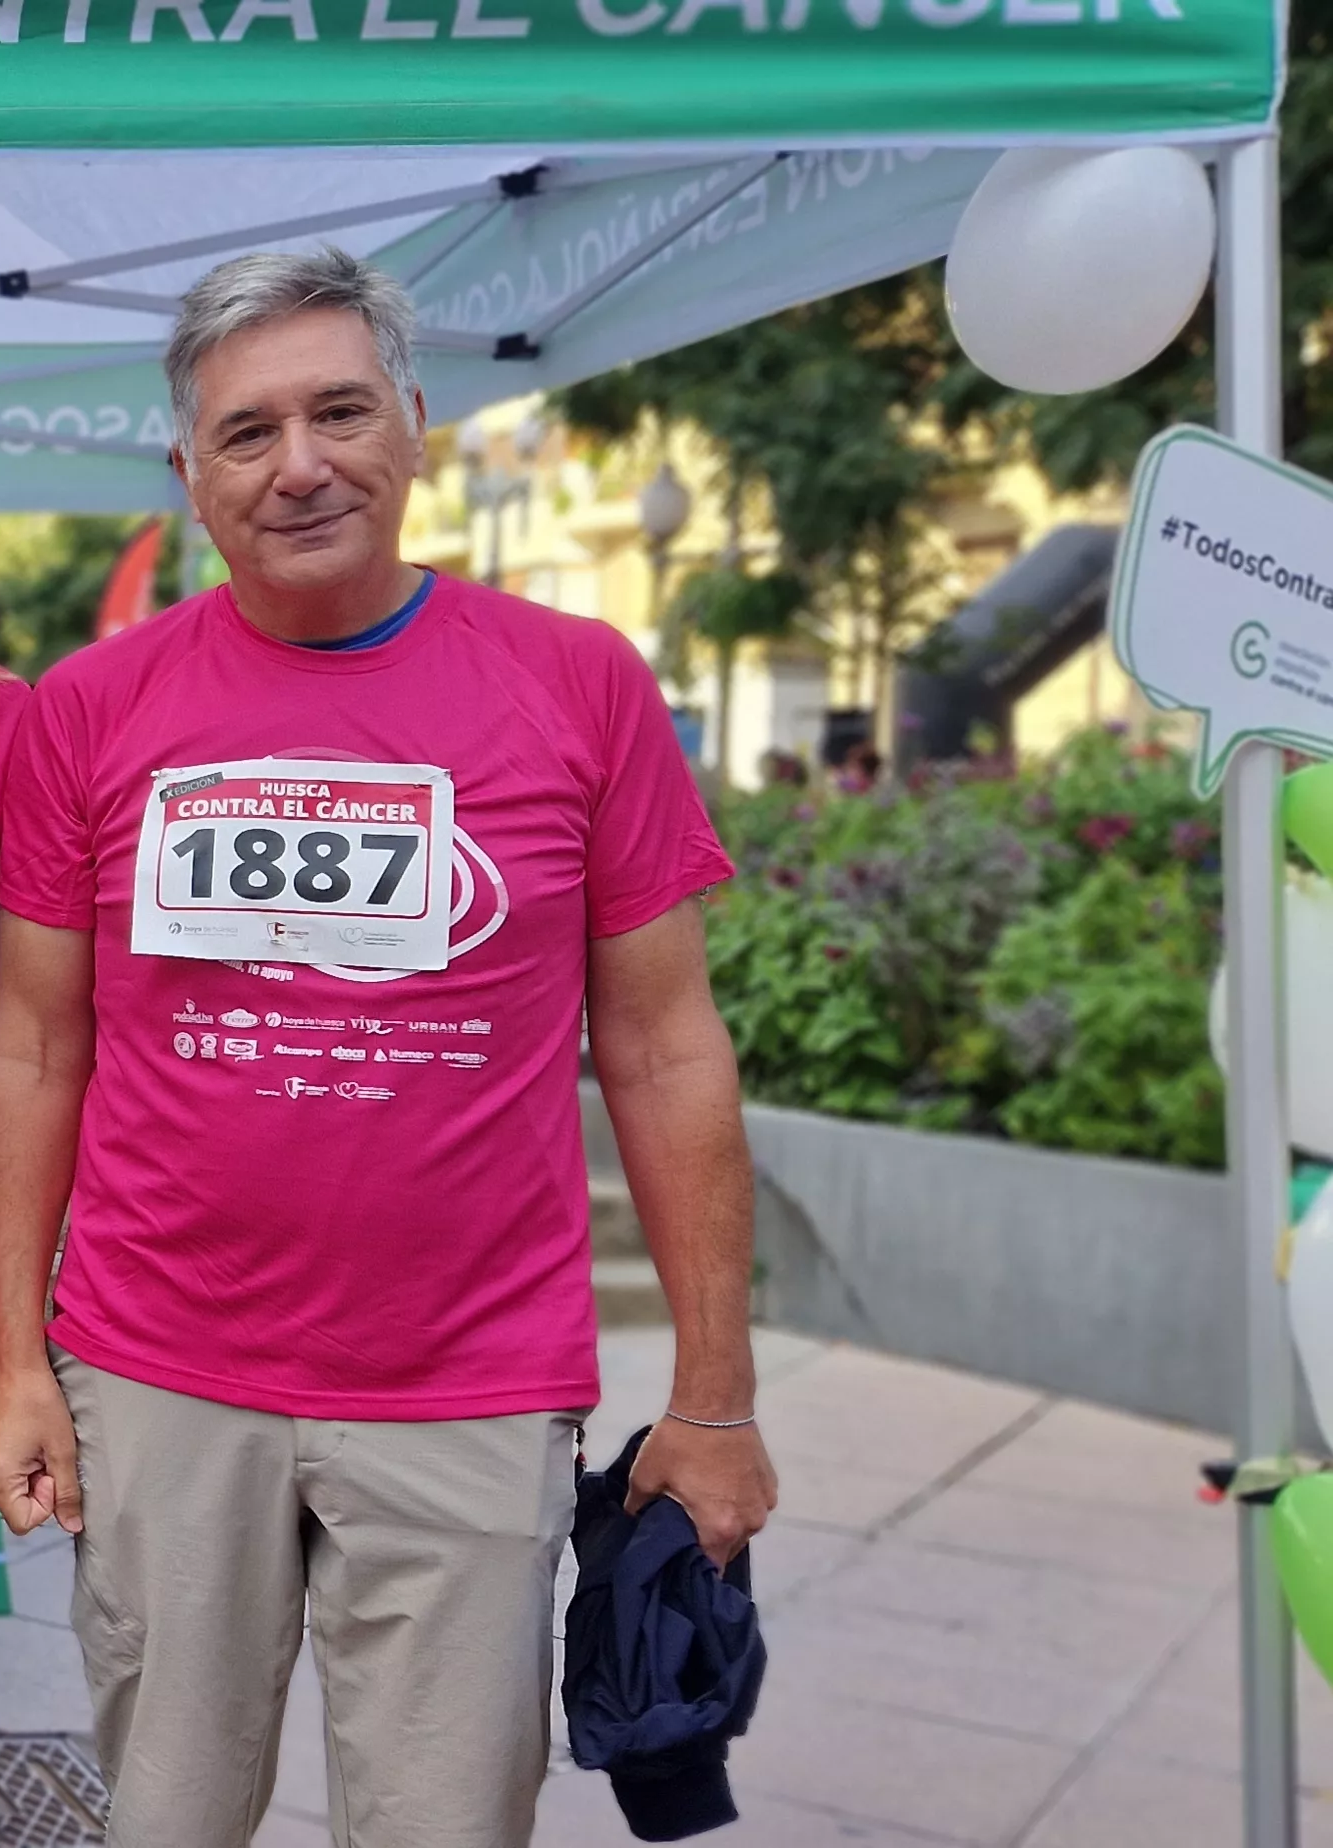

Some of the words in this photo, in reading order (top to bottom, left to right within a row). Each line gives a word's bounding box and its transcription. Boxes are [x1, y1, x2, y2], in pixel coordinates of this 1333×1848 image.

[165, 788, 174, 799] X
[174, 776, 217, 797] EDICIÓN
[259, 782, 331, 799] HUESCA
[177, 798, 274, 819] CONTRA
[283, 801, 308, 819] EL
[316, 798, 417, 823] CÁNCER
[171, 827, 421, 906] 1887
[247, 962, 260, 975] Te
[260, 964, 295, 982] apoyo
[350, 1014, 393, 1035] vive
[408, 1021, 458, 1032] URBAN
